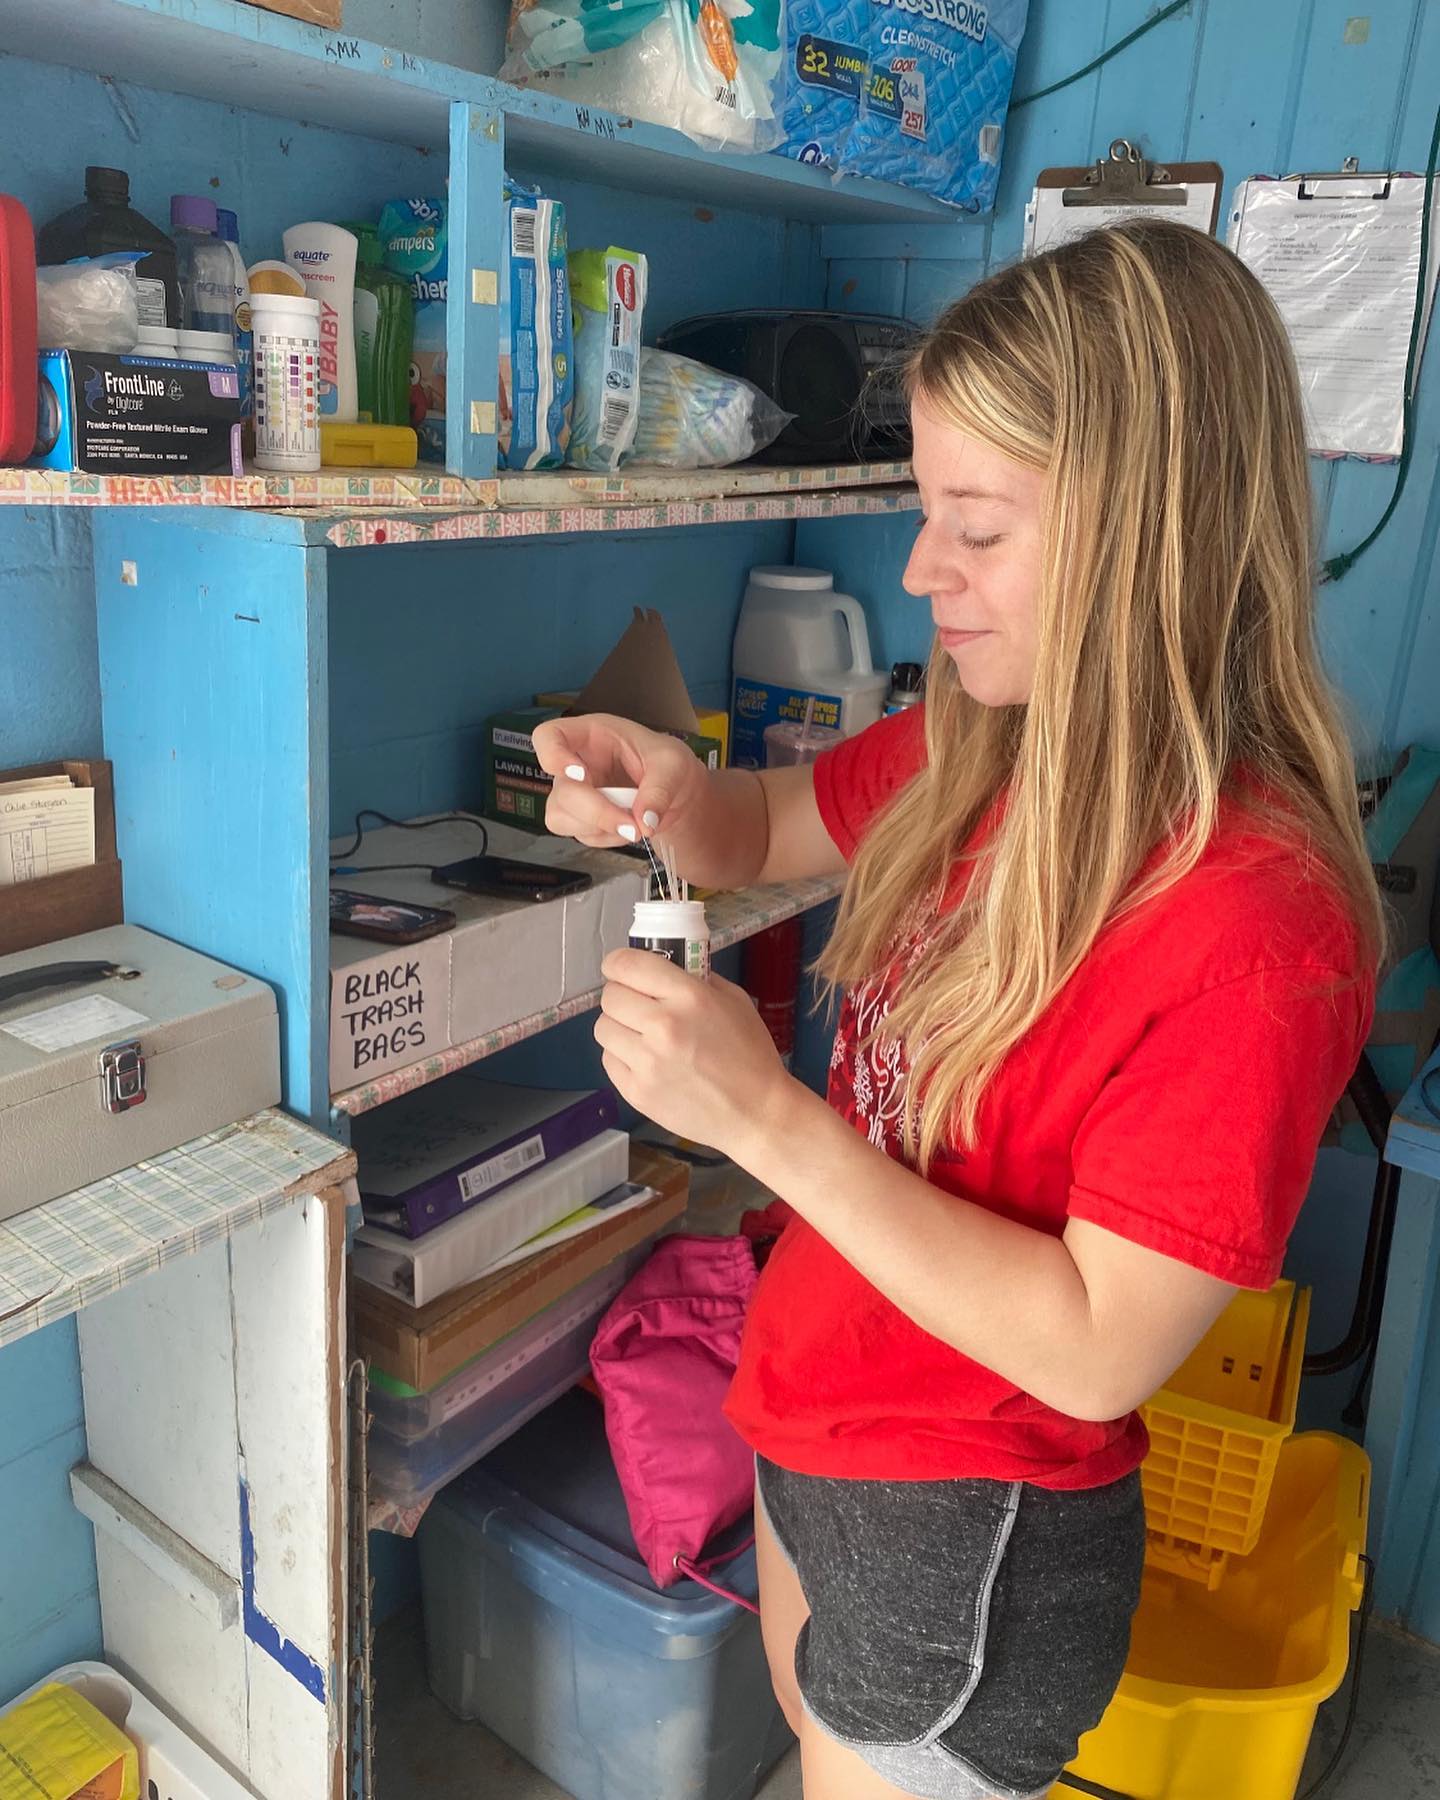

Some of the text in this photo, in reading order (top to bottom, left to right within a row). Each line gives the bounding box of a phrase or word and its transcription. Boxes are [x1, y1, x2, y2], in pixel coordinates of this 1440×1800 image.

[325, 41, 361, 59] KMK
[880, 26, 956, 67] CLEANSTRETCH
[802, 44, 831, 78] 32
[904, 110, 923, 131] 257
[294, 250, 330, 262] equate
[388, 235, 435, 256] ampers
[301, 272, 335, 282] nscreen
[320, 301, 339, 377] BABY
[104, 371, 165, 397] FrontLine
[222, 377, 232, 395] M
[789, 696, 839, 714] ALL-PRPOSE
[800, 709, 824, 724] CAN
[495, 759, 524, 777] LAWN
[345, 961, 421, 1004] BLACK
[341, 990, 424, 1036] TRASH
[353, 1021, 425, 1069] BAGS
